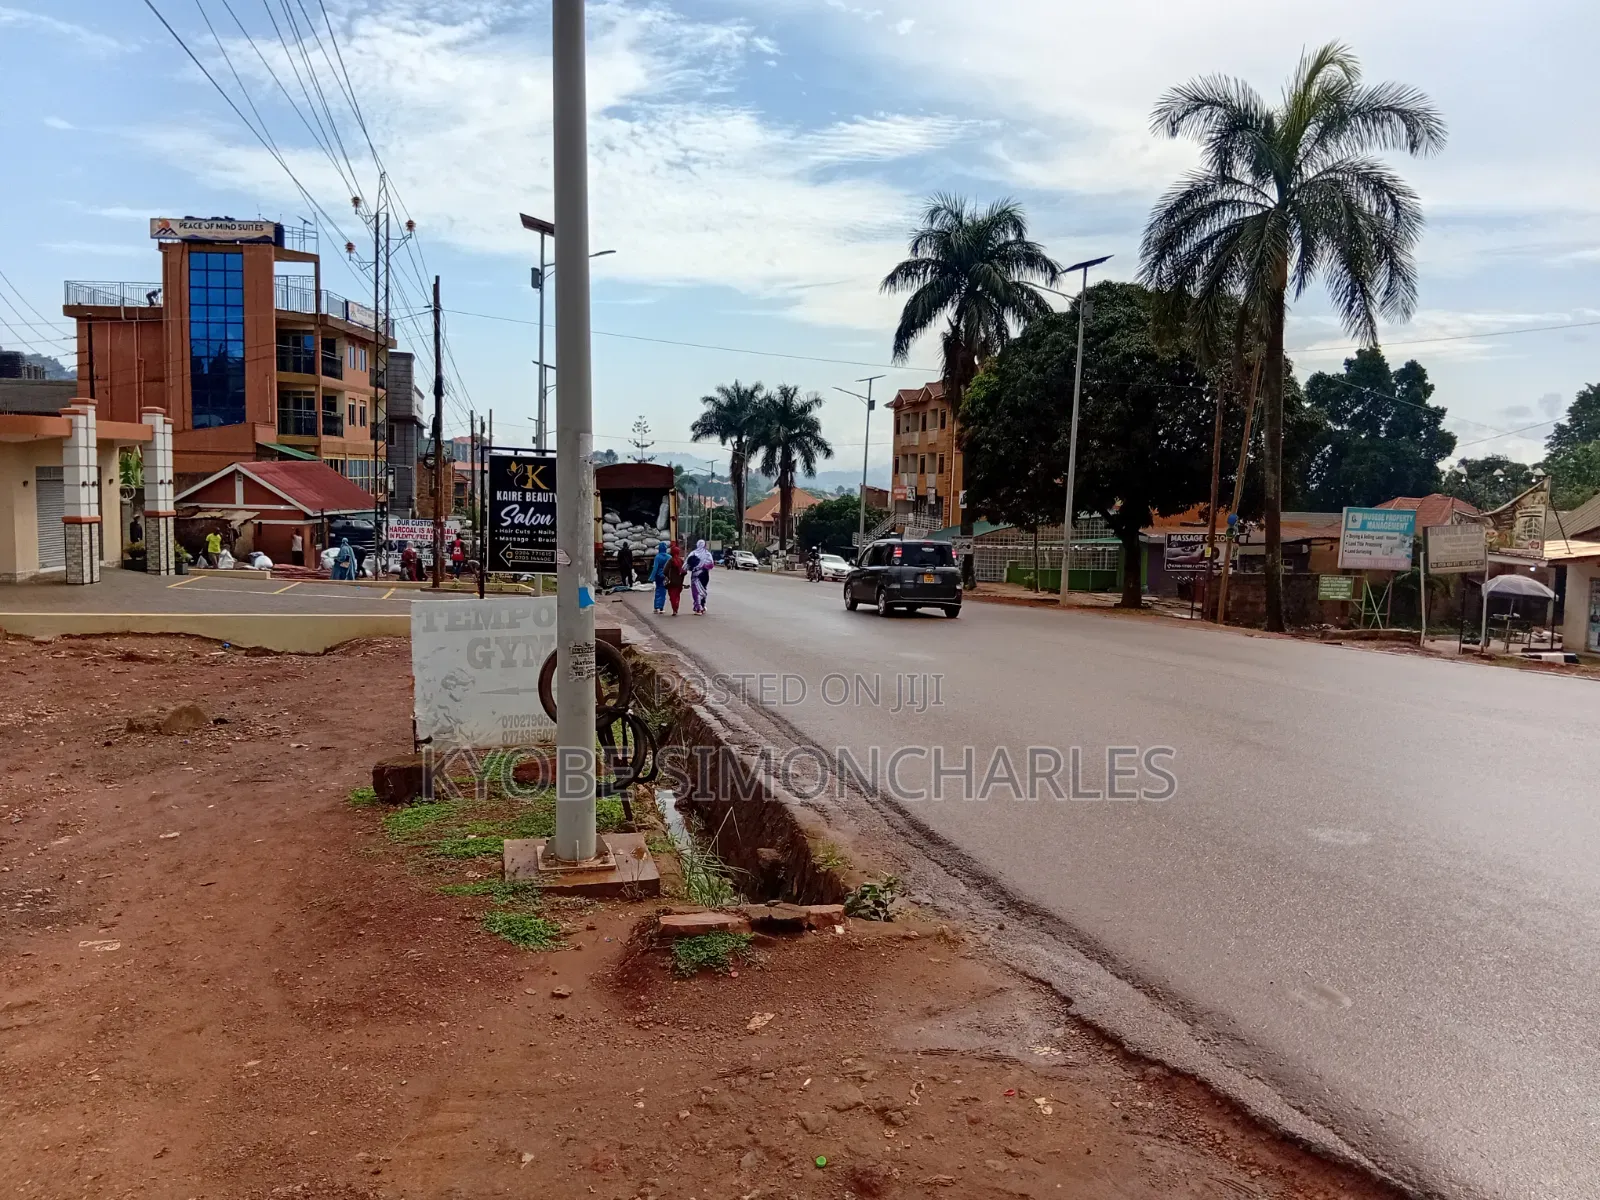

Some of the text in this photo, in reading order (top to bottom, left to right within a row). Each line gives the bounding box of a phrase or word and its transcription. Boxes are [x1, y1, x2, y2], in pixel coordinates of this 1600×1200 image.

[179, 222, 202, 230] PEACE
[204, 222, 214, 230] OF
[216, 223, 236, 231] MIND
[496, 490, 523, 502] KAIRE
[500, 503, 555, 527] Salon
[1385, 513, 1414, 522] PROPERTY
[387, 526, 417, 534] HARCOAL
[1366, 521, 1409, 531] MANAGEMENT
[1170, 534, 1203, 542] MASSAGE
[453, 547, 461, 555] 23
[417, 605, 557, 633] TEMPO
[466, 634, 557, 670] GYM
